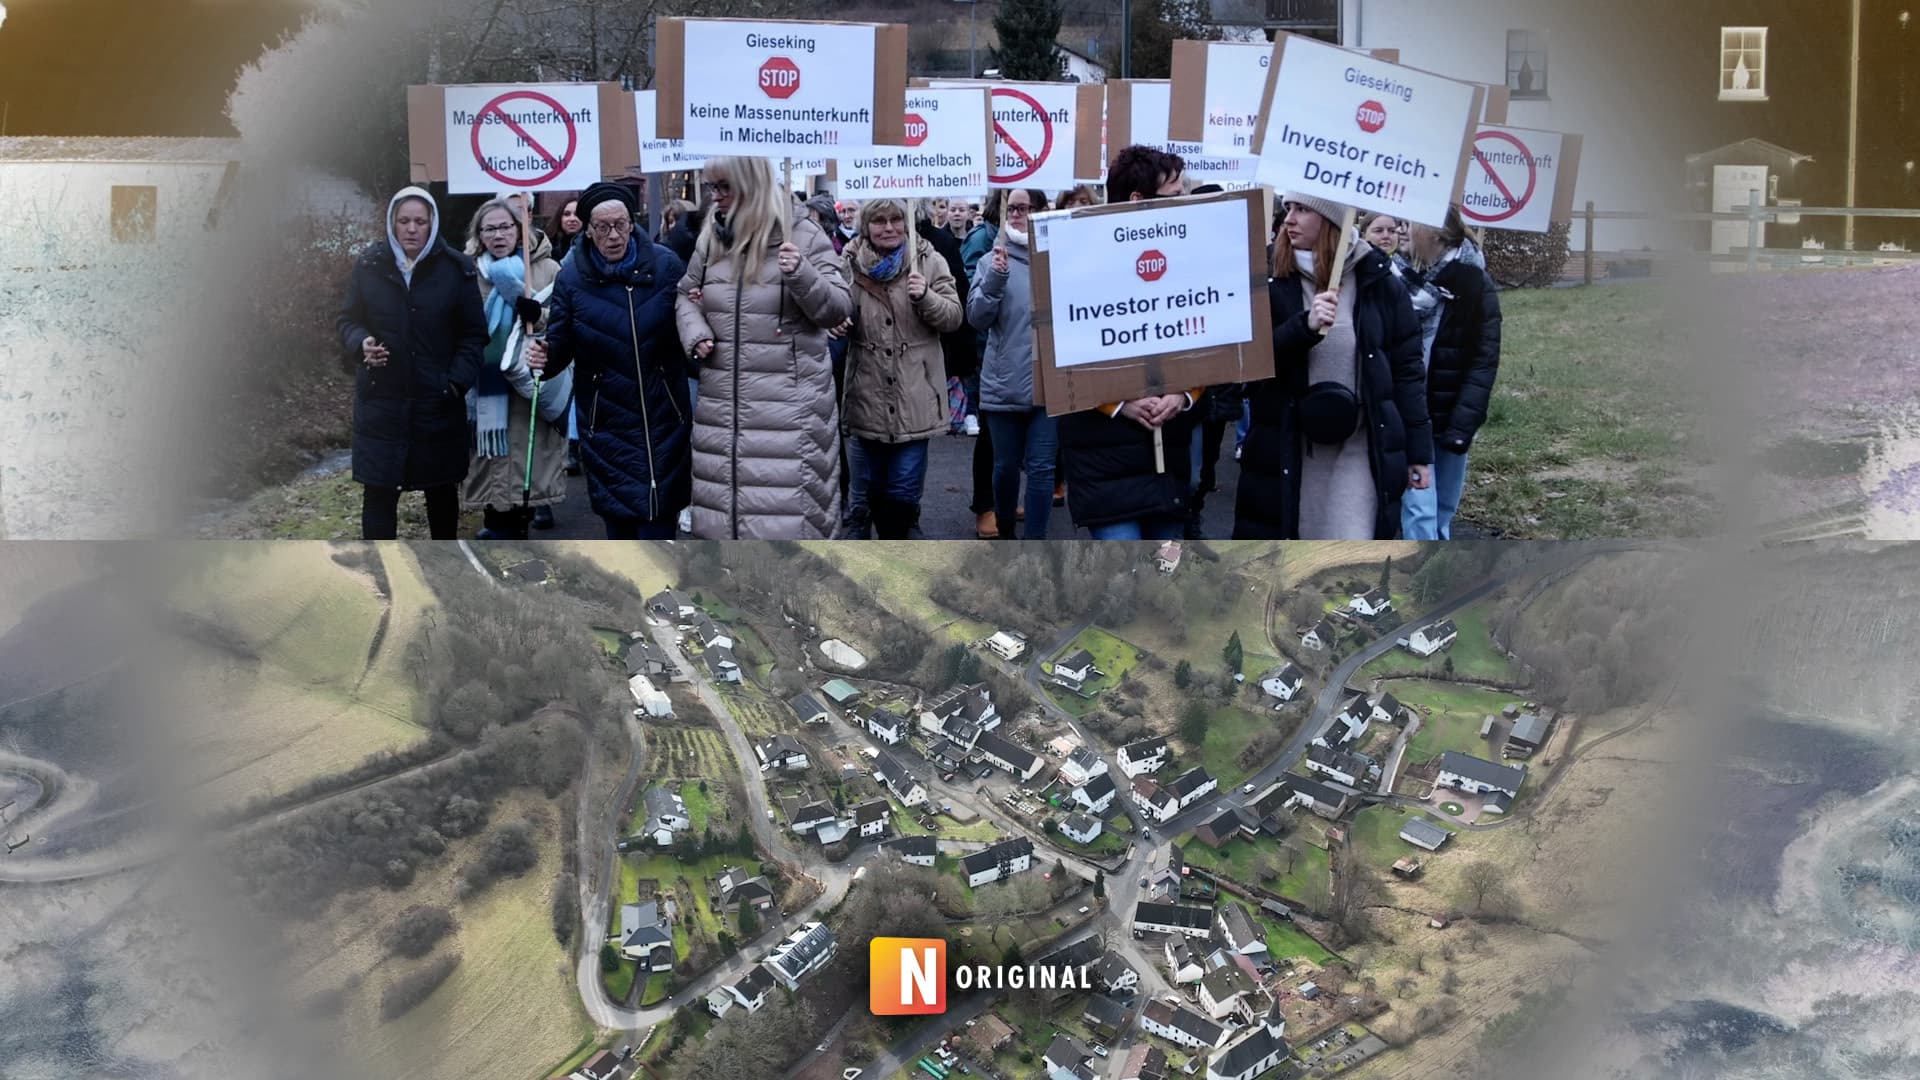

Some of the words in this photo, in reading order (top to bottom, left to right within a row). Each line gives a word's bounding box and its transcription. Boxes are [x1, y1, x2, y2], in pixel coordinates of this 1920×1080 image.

[746, 34, 815, 53] Gieseking
[761, 69, 798, 87] STOP
[1344, 67, 1413, 102] Gieseking
[453, 108, 592, 126] Massenunterkunft
[690, 103, 730, 119] keine
[735, 104, 869, 123] Massenunterkunft
[1209, 112, 1243, 127] keine
[1357, 107, 1386, 126] STOP
[517, 137, 531, 148] in
[642, 140, 667, 150] keine
[720, 127, 733, 142] in
[738, 128, 838, 145] Michelbach!!!
[1233, 134, 1245, 147] in
[662, 153, 671, 163] in
[897, 153, 972, 167] Michelbach
[1281, 124, 1370, 163] Investor
[1375, 152, 1426, 178] reich
[480, 155, 568, 171] Michelbach
[845, 175, 869, 190] soll
[872, 175, 924, 189] Zukunft
[928, 173, 981, 188] haben!!!
[1304, 161, 1352, 189] Dorf
[1356, 174, 1406, 203] tot!!!
[1113, 222, 1187, 243] Gieseking
[1137, 258, 1165, 274] STOP
[1068, 296, 1160, 322] Investor
[1167, 286, 1220, 310] reich
[1101, 323, 1149, 347] Dorf
[1155, 315, 1206, 340] tot!!!
